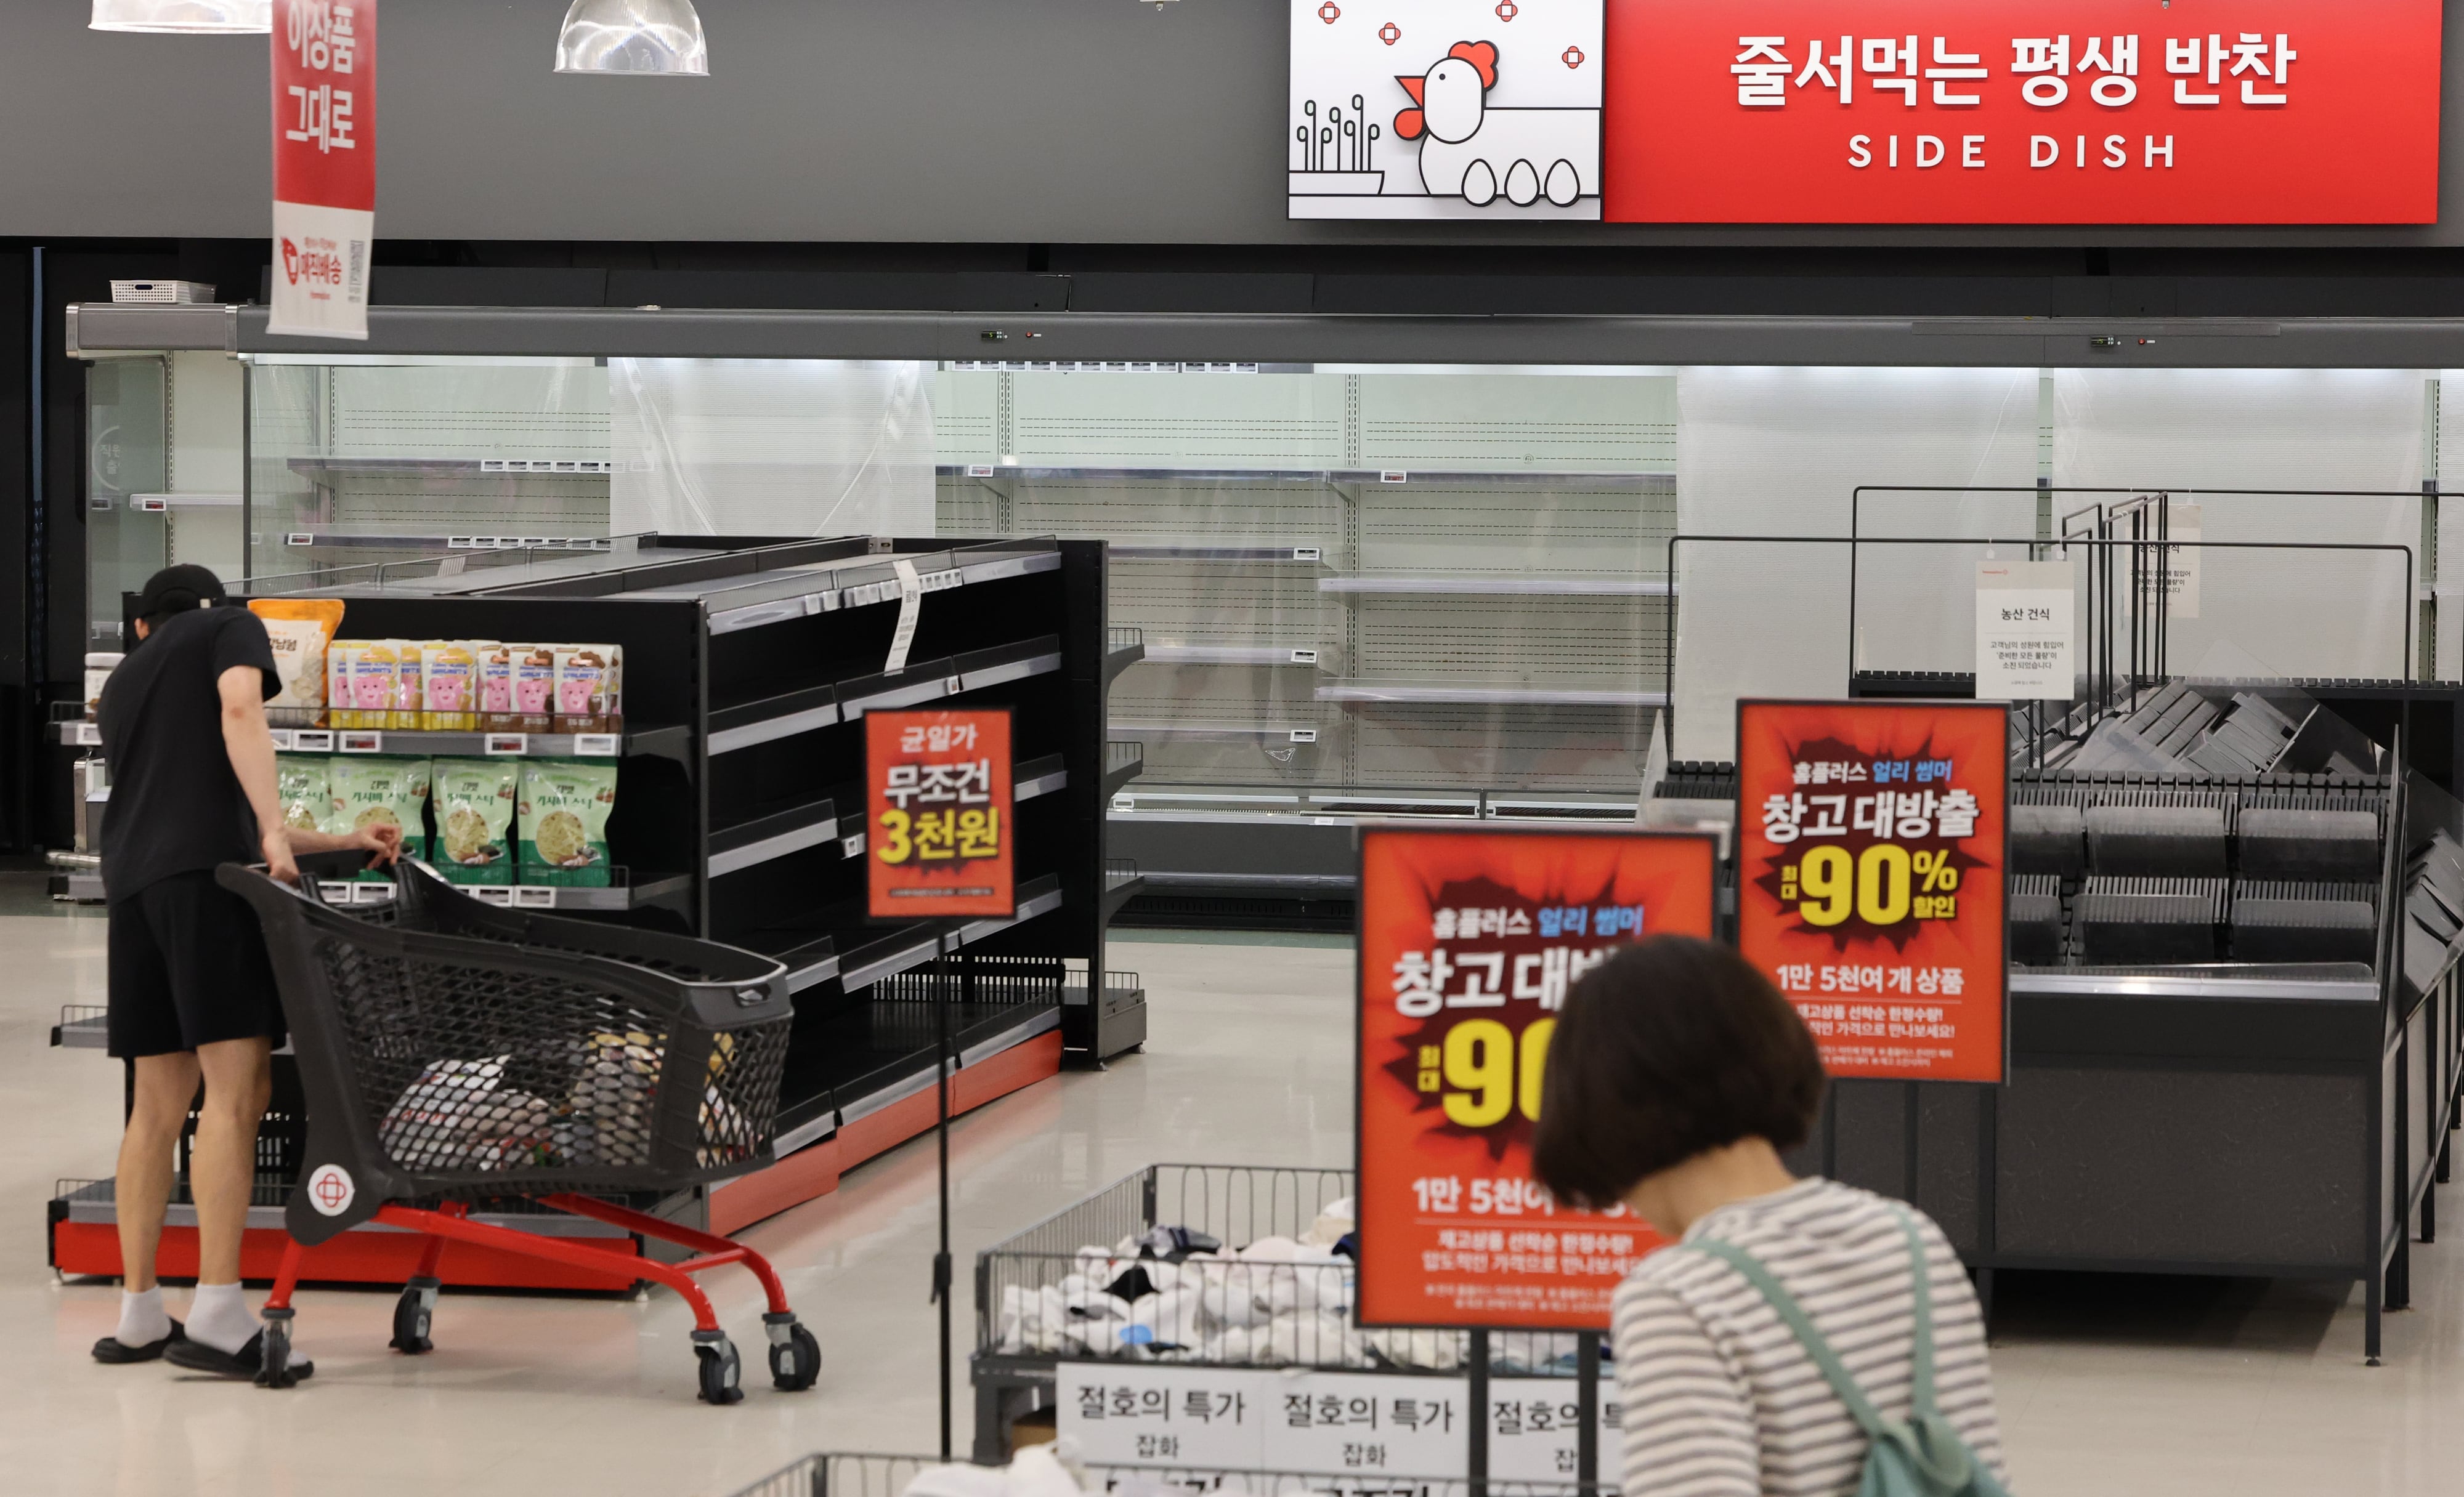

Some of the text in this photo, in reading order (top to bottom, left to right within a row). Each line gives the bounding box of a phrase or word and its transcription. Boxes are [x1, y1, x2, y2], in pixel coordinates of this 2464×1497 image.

[1730, 33, 2297, 107] 줄서먹는 평생 반찬
[286, 84, 355, 155] 그대로
[1847, 135, 2174, 168] SIDE DISH
[2001, 608, 2049, 621] 농산 건식
[1990, 641, 2018, 649] 고객님의
[900, 722, 978, 753] 균일가
[883, 758, 990, 809] 무조건
[1793, 759, 1953, 785] 홈플러스 얼리 썸머
[877, 806, 999, 864] 3천원
[1432, 907, 1531, 939] 홈플러스
[1538, 906, 1588, 937] 얼리
[1913, 895, 1956, 919] 할인
[1776, 963, 1814, 991] 1만
[1916, 967, 1964, 996] 상품
[1412, 1175, 1463, 1214] 1만
[1078, 1384, 1246, 1424] 절호의 특가
[1283, 1393, 1453, 1432] 절호의 특가
[1137, 1434, 1180, 1459] 잡화
[1343, 1442, 1387, 1468] 잡화
